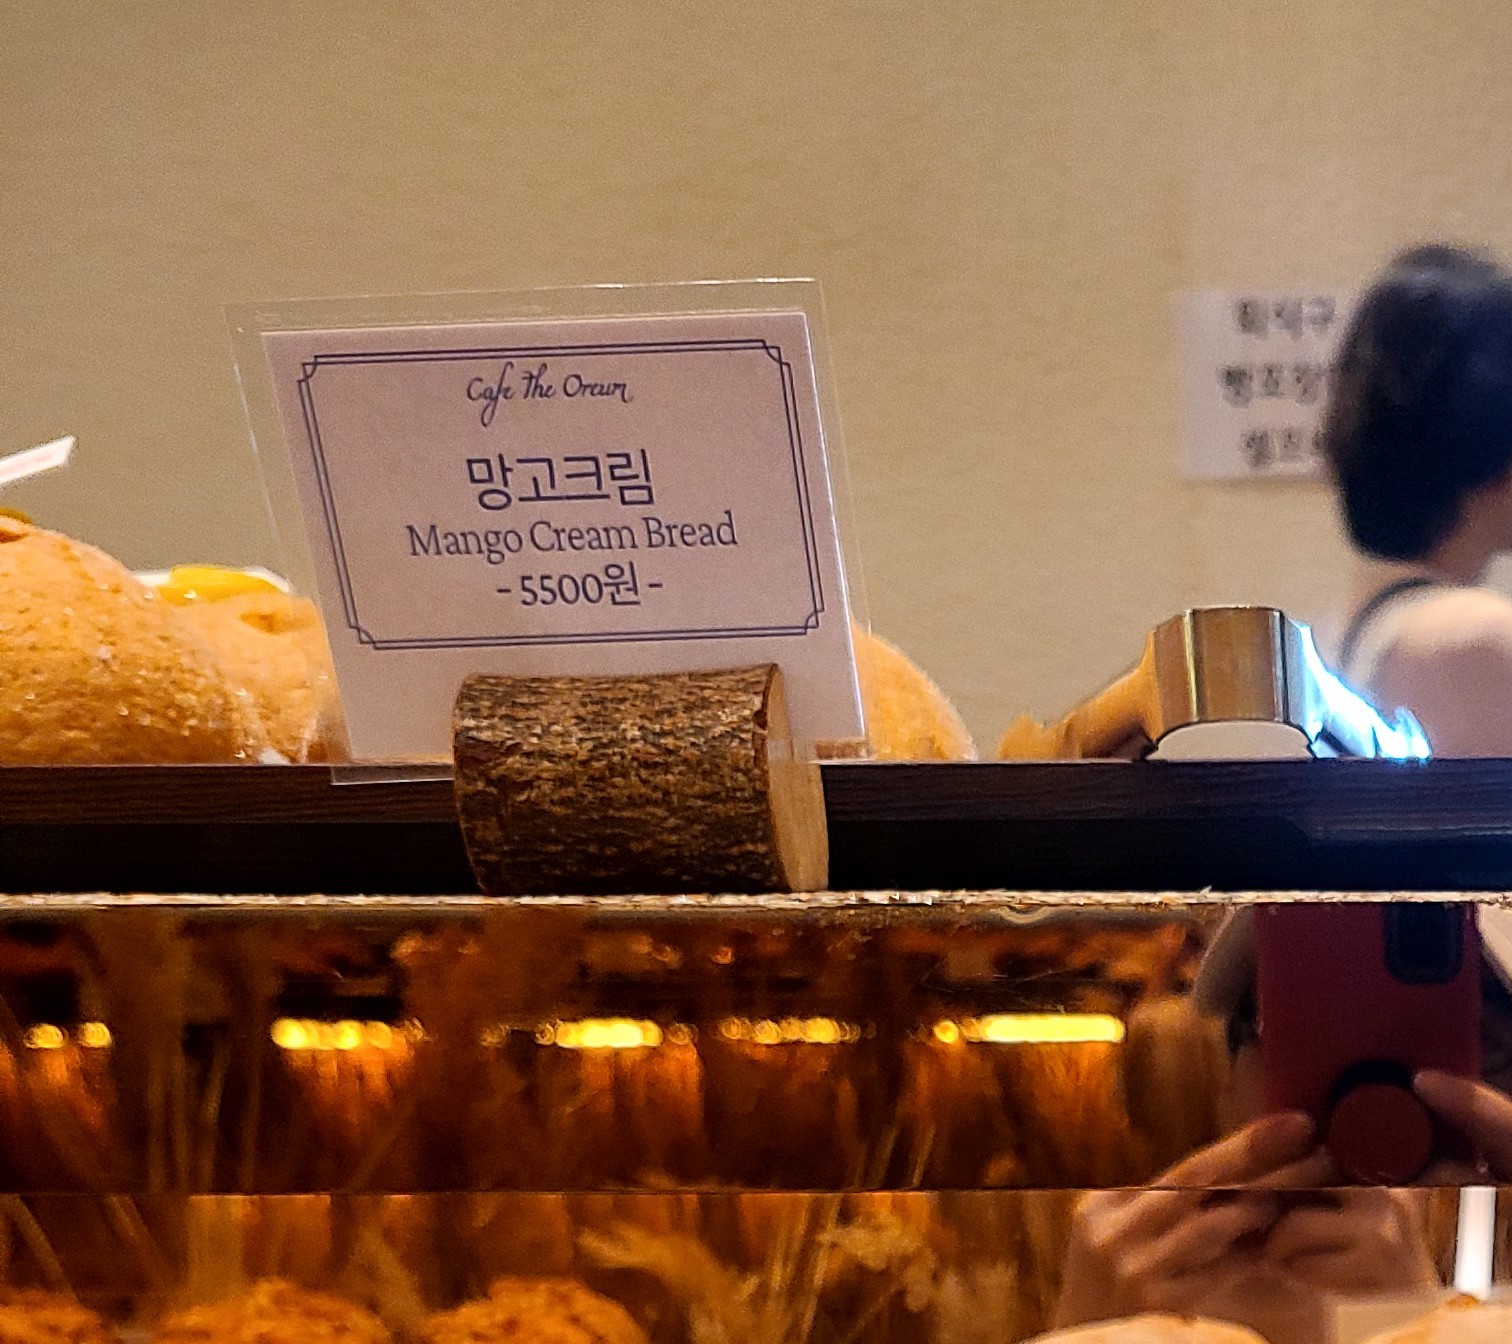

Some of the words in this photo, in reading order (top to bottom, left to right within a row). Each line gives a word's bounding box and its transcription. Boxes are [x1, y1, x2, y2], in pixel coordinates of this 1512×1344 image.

[467, 361, 515, 428] Cafe
[522, 363, 555, 400] The
[466, 449, 655, 511] 망고크림
[406, 524, 523, 565] Mango
[530, 520, 639, 552] Cream
[642, 510, 738, 549] Bread
